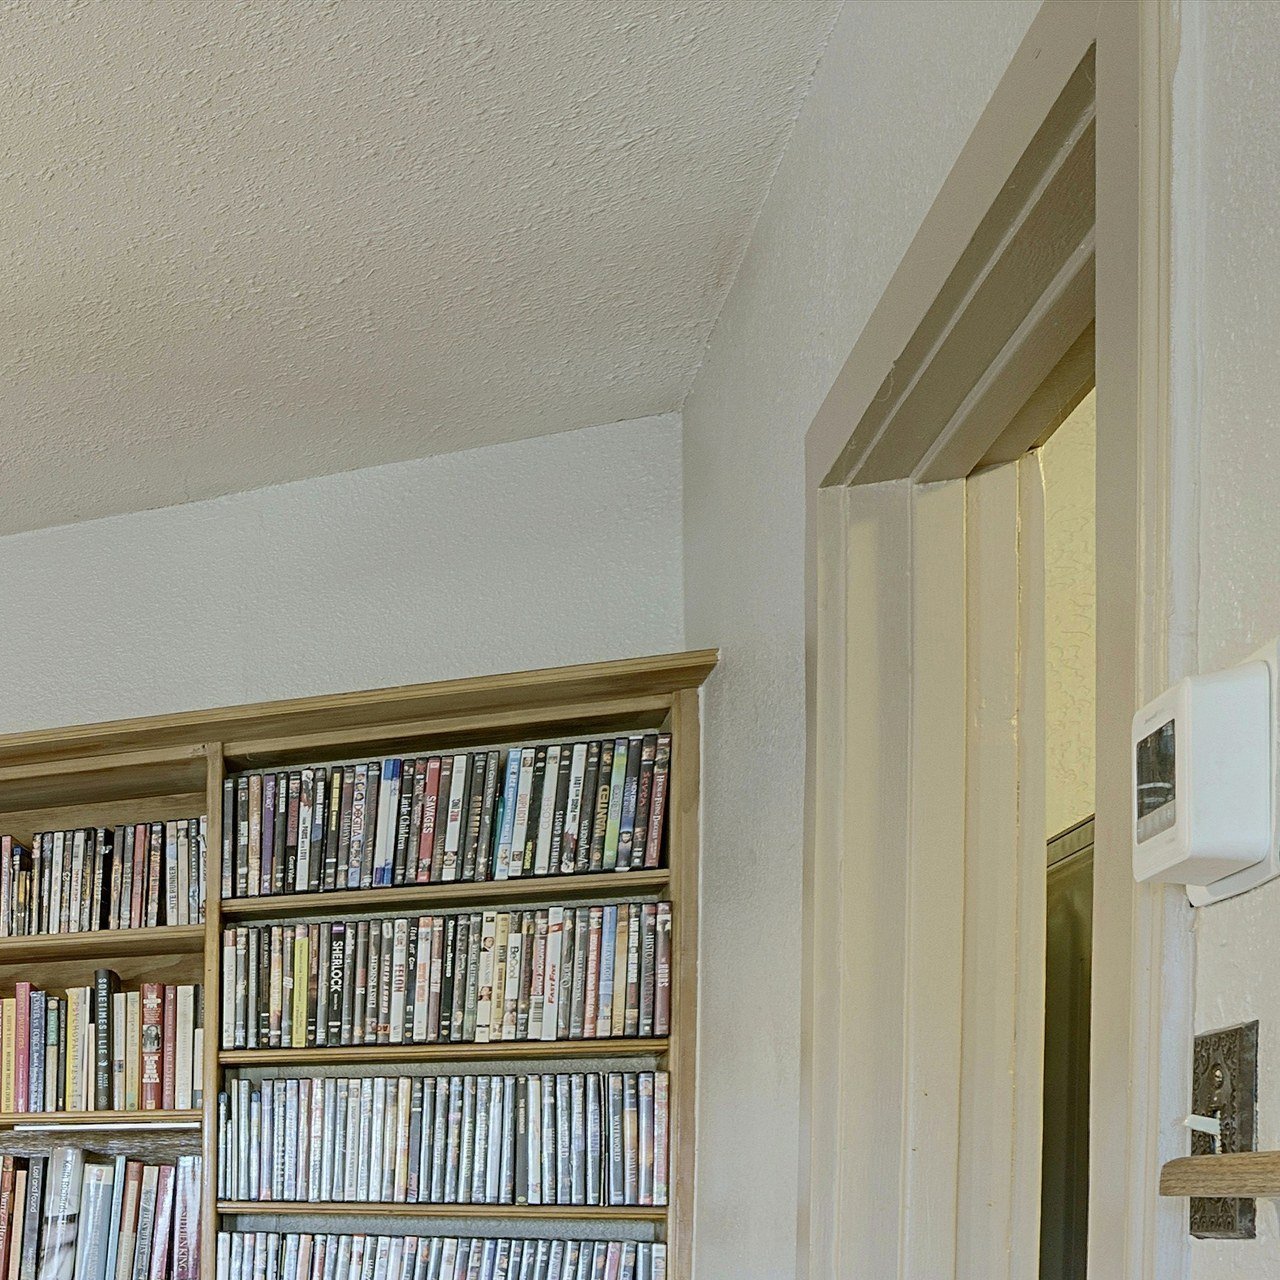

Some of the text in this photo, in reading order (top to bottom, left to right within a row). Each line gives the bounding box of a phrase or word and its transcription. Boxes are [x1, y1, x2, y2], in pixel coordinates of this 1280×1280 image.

[398, 793, 412, 850] Little Children
[423, 795, 436, 834] SAVAGES
[516, 793, 528, 826] DUPLICITY
[541, 795, 553, 830] CLOSER
[594, 784, 610, 838] WANTED
[330, 940, 344, 992] SHERLOCK
[393, 963, 404, 993] FELON
[33, 993, 41, 1019] POWER
[97, 977, 108, 1030] SOMETIMES
[98, 1039, 108, 1055] LIE
[32, 1165, 40, 1180] Lost
[60, 1159, 69, 1179] Keith
[31, 1180, 40, 1192] and
[30, 1192, 39, 1213] Found
[178, 1247, 188, 1272] KING
